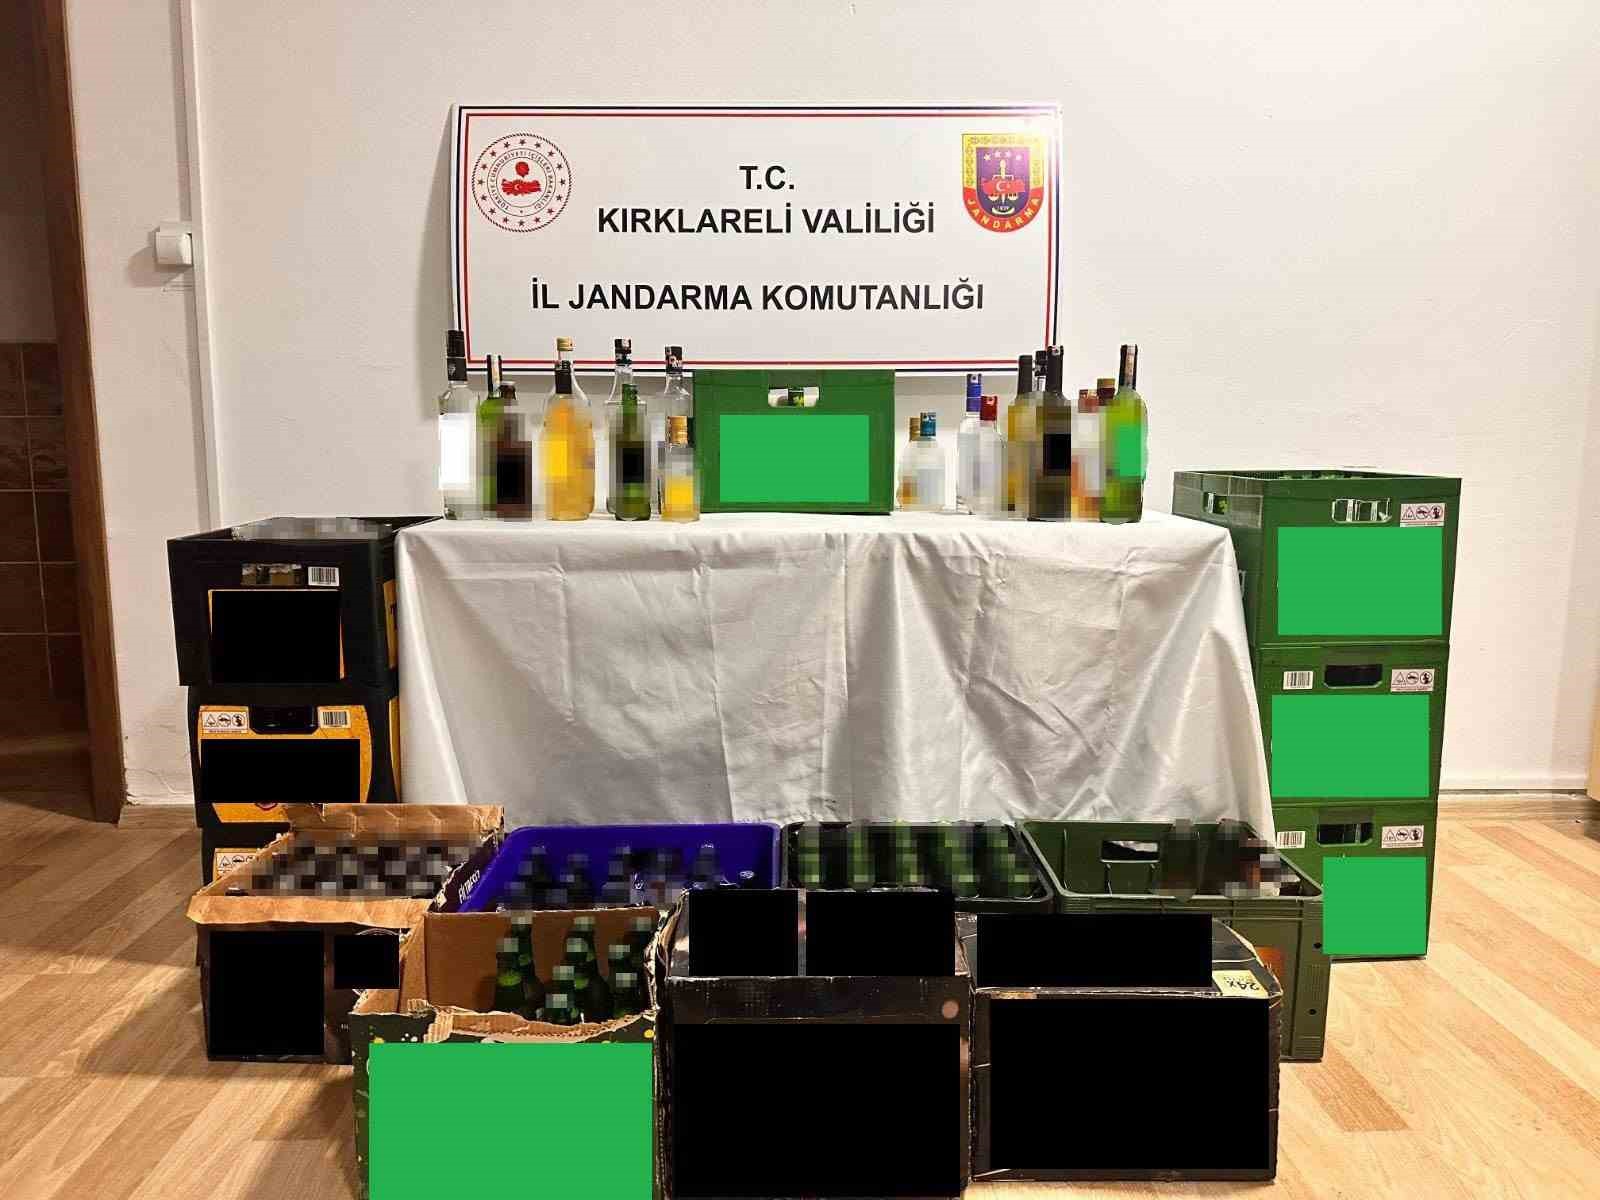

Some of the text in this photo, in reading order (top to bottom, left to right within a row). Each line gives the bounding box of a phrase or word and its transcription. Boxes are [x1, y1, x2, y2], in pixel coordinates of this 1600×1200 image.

[739, 165, 795, 190] T.C.
[598, 201, 934, 234] KIRKLARELİ VALİLİĞİ
[967, 198, 1040, 229] JANDARMA
[532, 277, 983, 311] İL JANDARMA KOMUTANLIĞI
